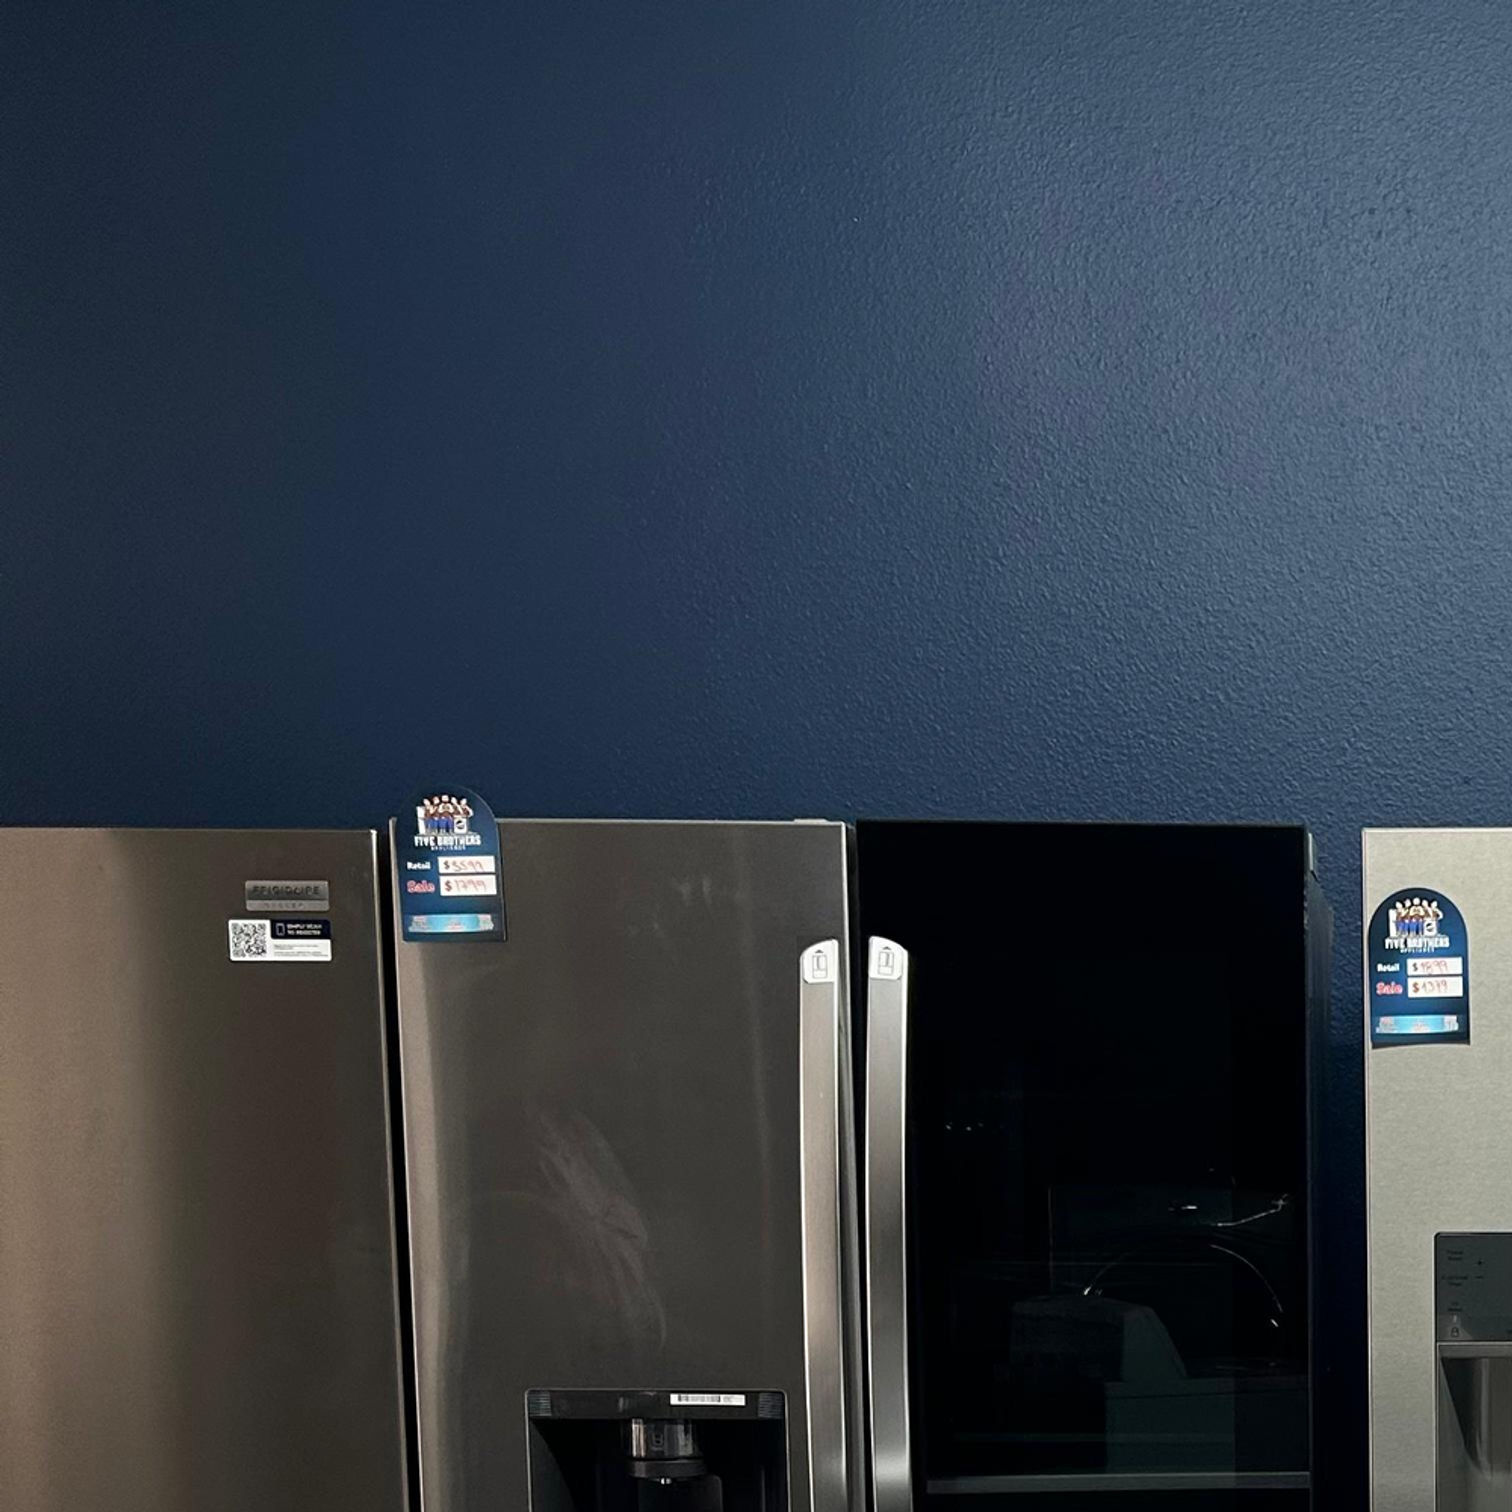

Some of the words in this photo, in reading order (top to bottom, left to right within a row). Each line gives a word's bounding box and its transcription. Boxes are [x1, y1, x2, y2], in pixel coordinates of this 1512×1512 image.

[406, 861, 431, 870] Retail
[406, 880, 436, 893] Sale
[1376, 963, 1400, 972] Retail
